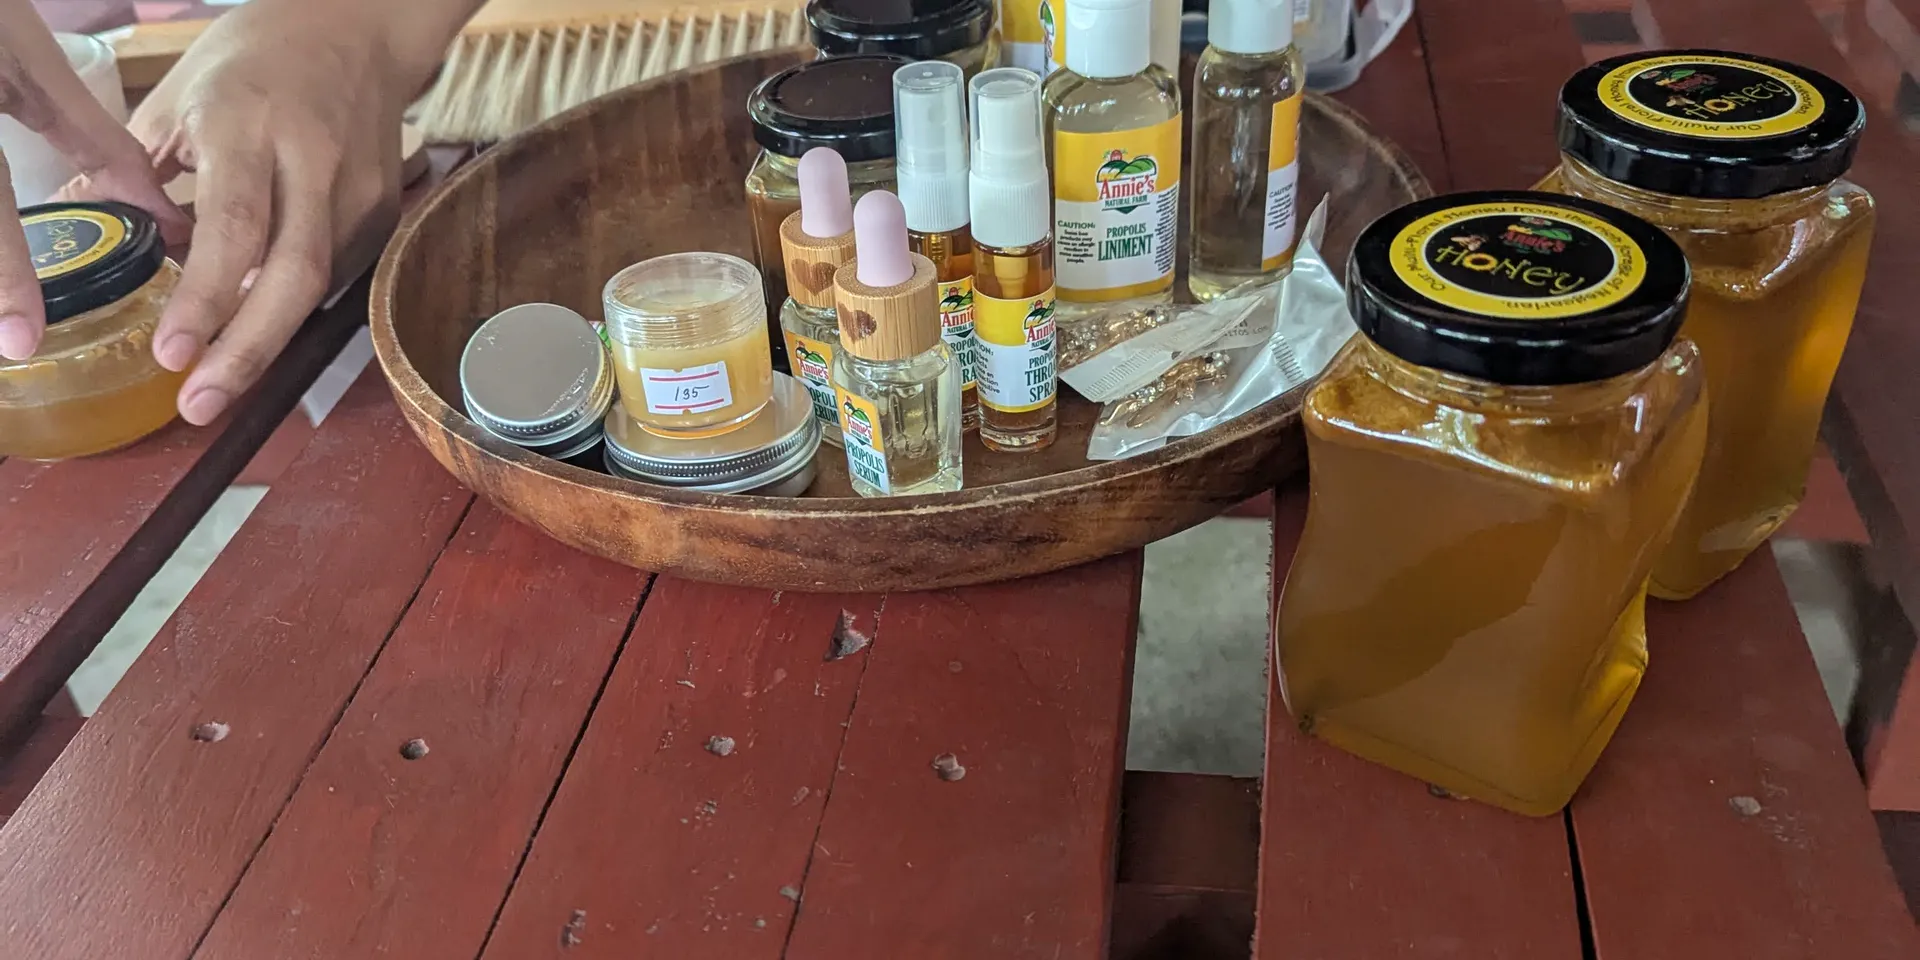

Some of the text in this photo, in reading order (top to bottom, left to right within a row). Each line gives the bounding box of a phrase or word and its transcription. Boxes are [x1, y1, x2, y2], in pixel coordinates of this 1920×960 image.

[1100, 174, 1155, 200] Annie's
[1106, 222, 1147, 239] PROPOLIS
[1097, 233, 1154, 262] LINIMENT
[800, 358, 829, 380] Annie's
[675, 385, 710, 401] 135
[814, 403, 839, 425] ERUM
[845, 438, 885, 474] PROPOLIS
[854, 459, 881, 488] SERUM
